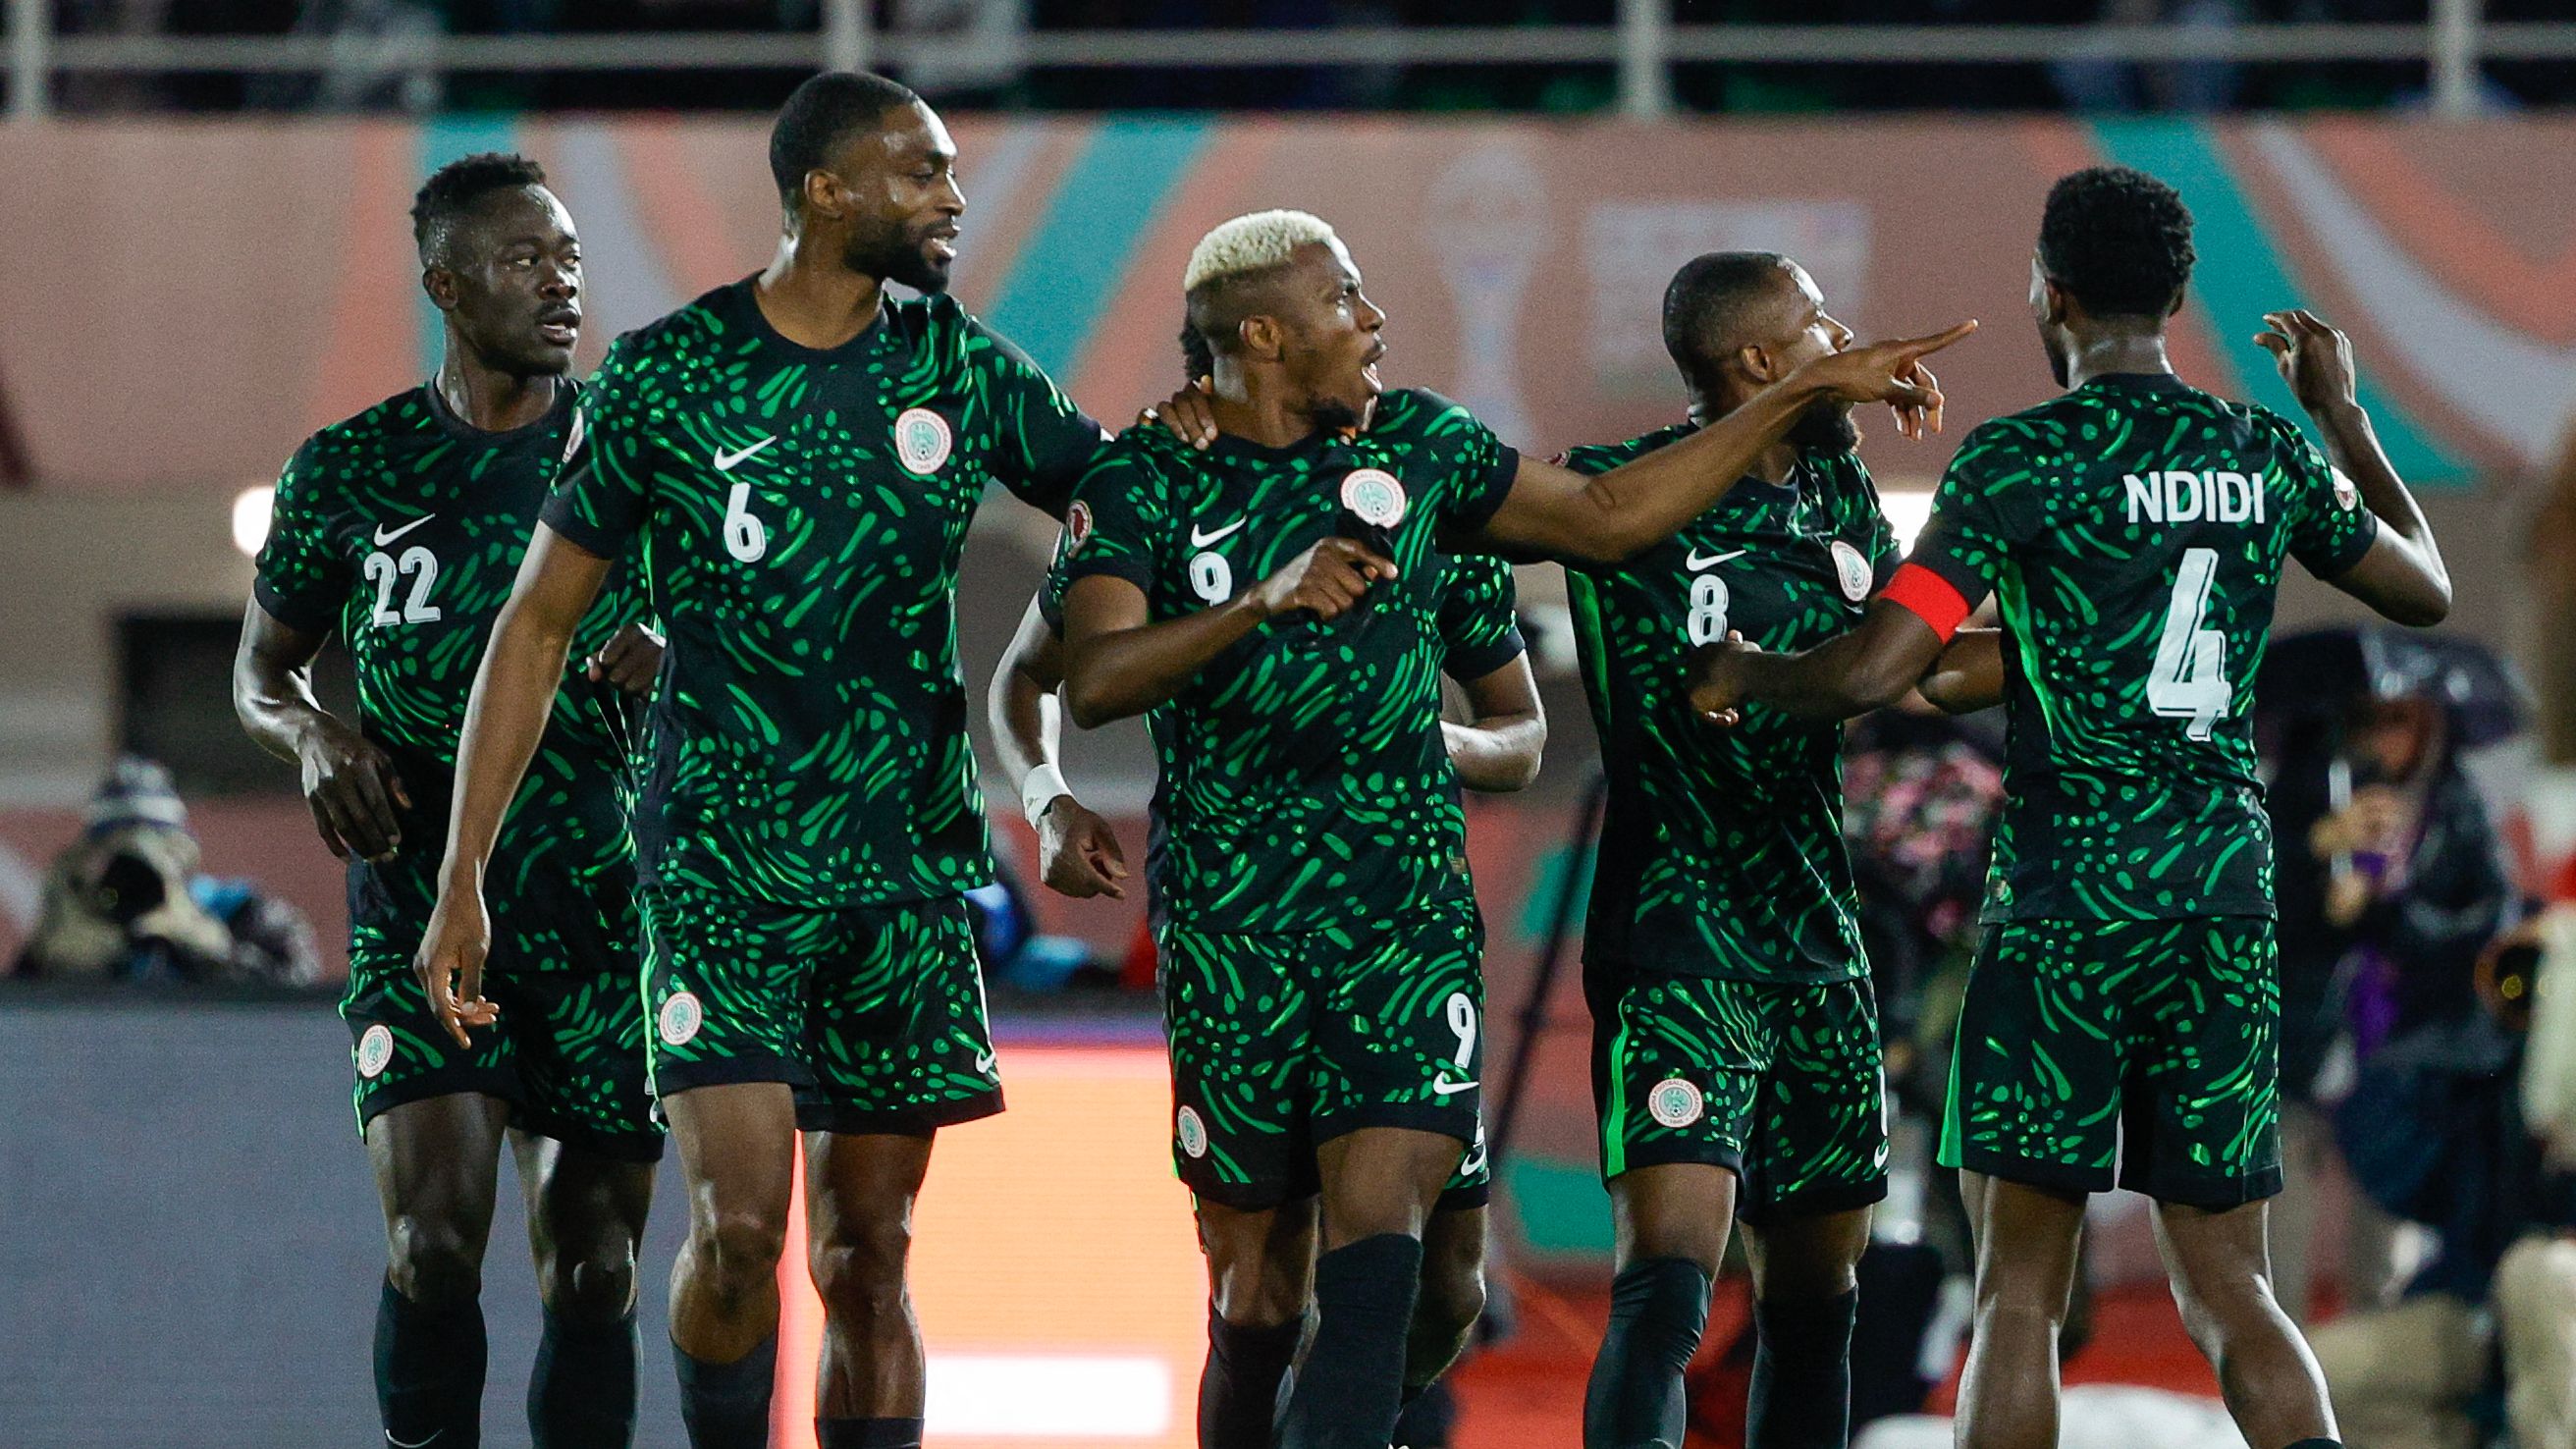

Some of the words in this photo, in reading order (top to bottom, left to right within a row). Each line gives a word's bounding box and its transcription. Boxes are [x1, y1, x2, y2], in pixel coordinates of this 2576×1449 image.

[723, 481, 768, 564] 6
[2122, 470, 2266, 524] NDIDI
[363, 545, 442, 628] 22
[1687, 573, 1730, 648] 8
[2146, 547, 2233, 742] 4
[1446, 992, 1476, 1070] 9
